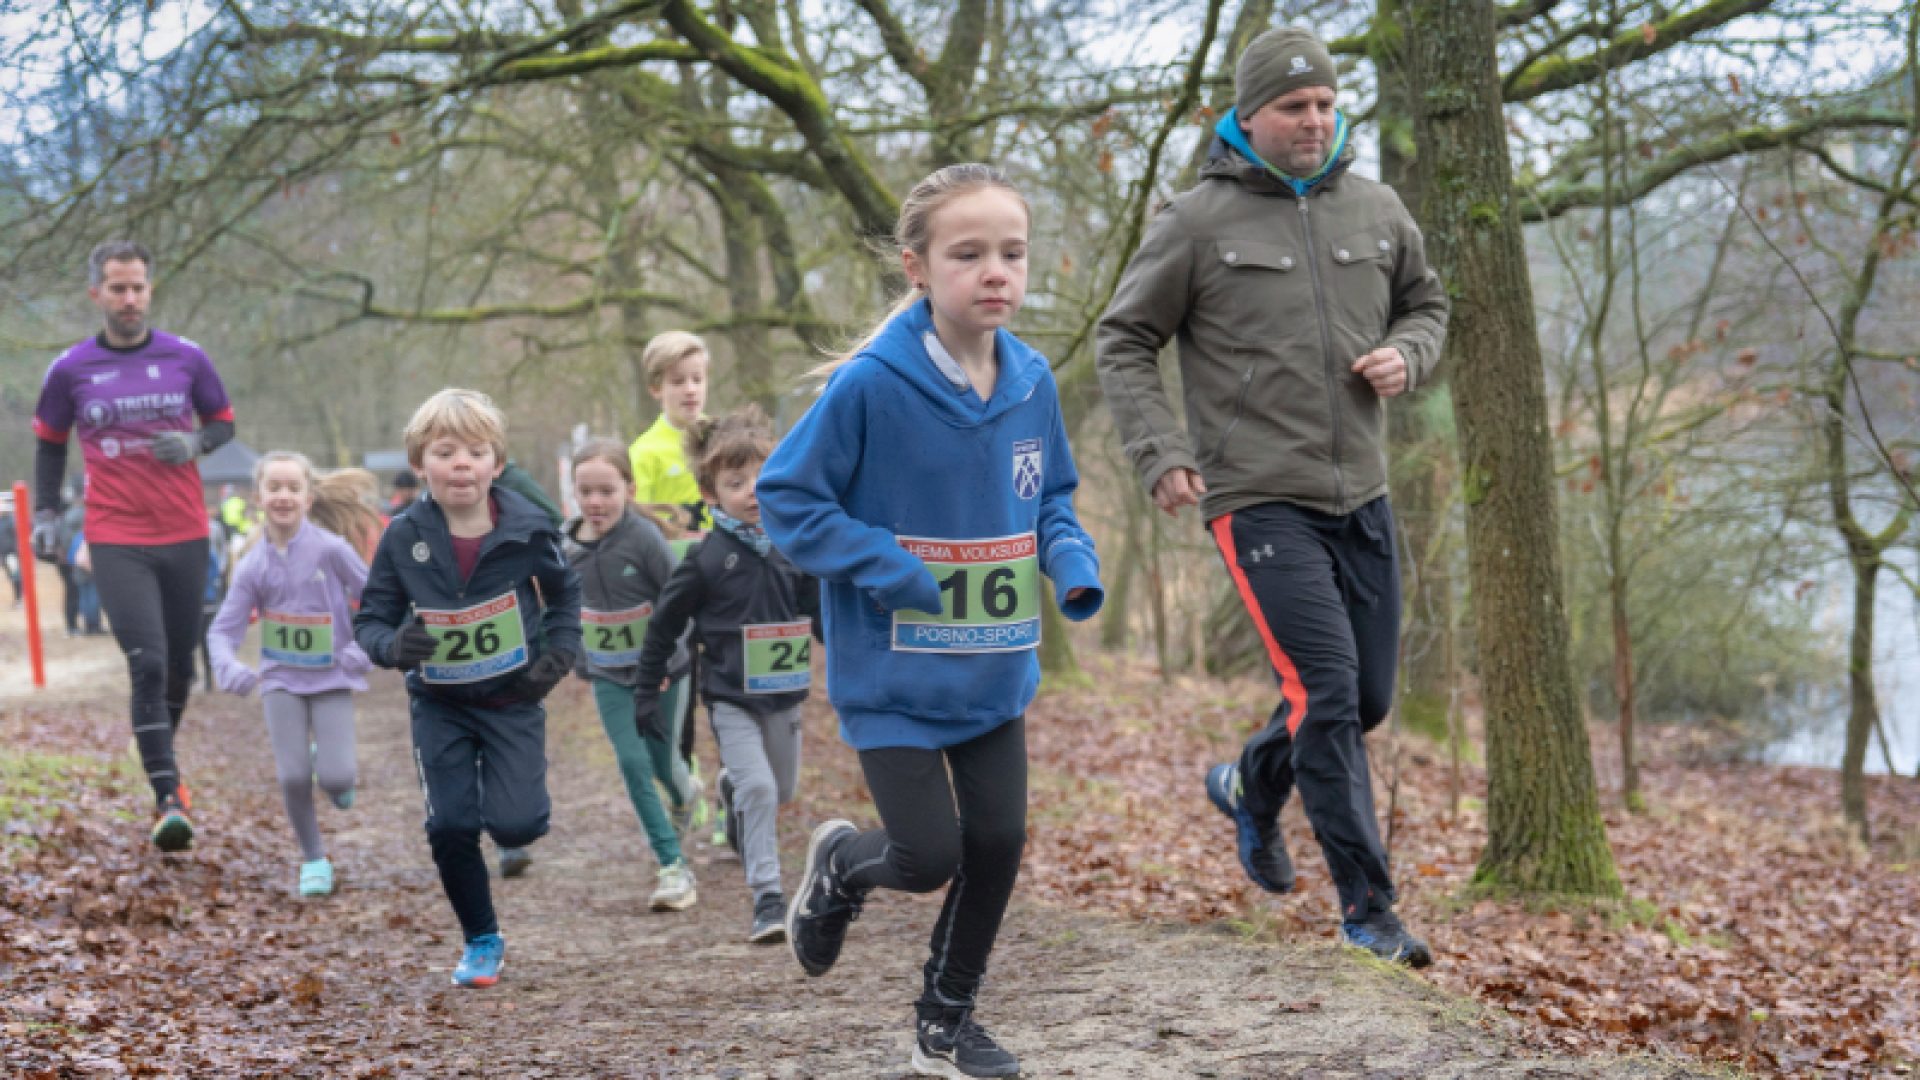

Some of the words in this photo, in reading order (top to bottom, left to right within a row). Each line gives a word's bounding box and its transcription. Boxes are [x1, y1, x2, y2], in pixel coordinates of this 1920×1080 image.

[113, 393, 186, 409] TRITEAM
[909, 544, 953, 560] HEMA
[959, 540, 1033, 560] VOLKSLOOP
[938, 567, 1018, 620] 16
[274, 626, 313, 651] 10
[443, 622, 500, 661] 26
[595, 625, 635, 651] 21
[915, 623, 1033, 643] POSNO-SPORT
